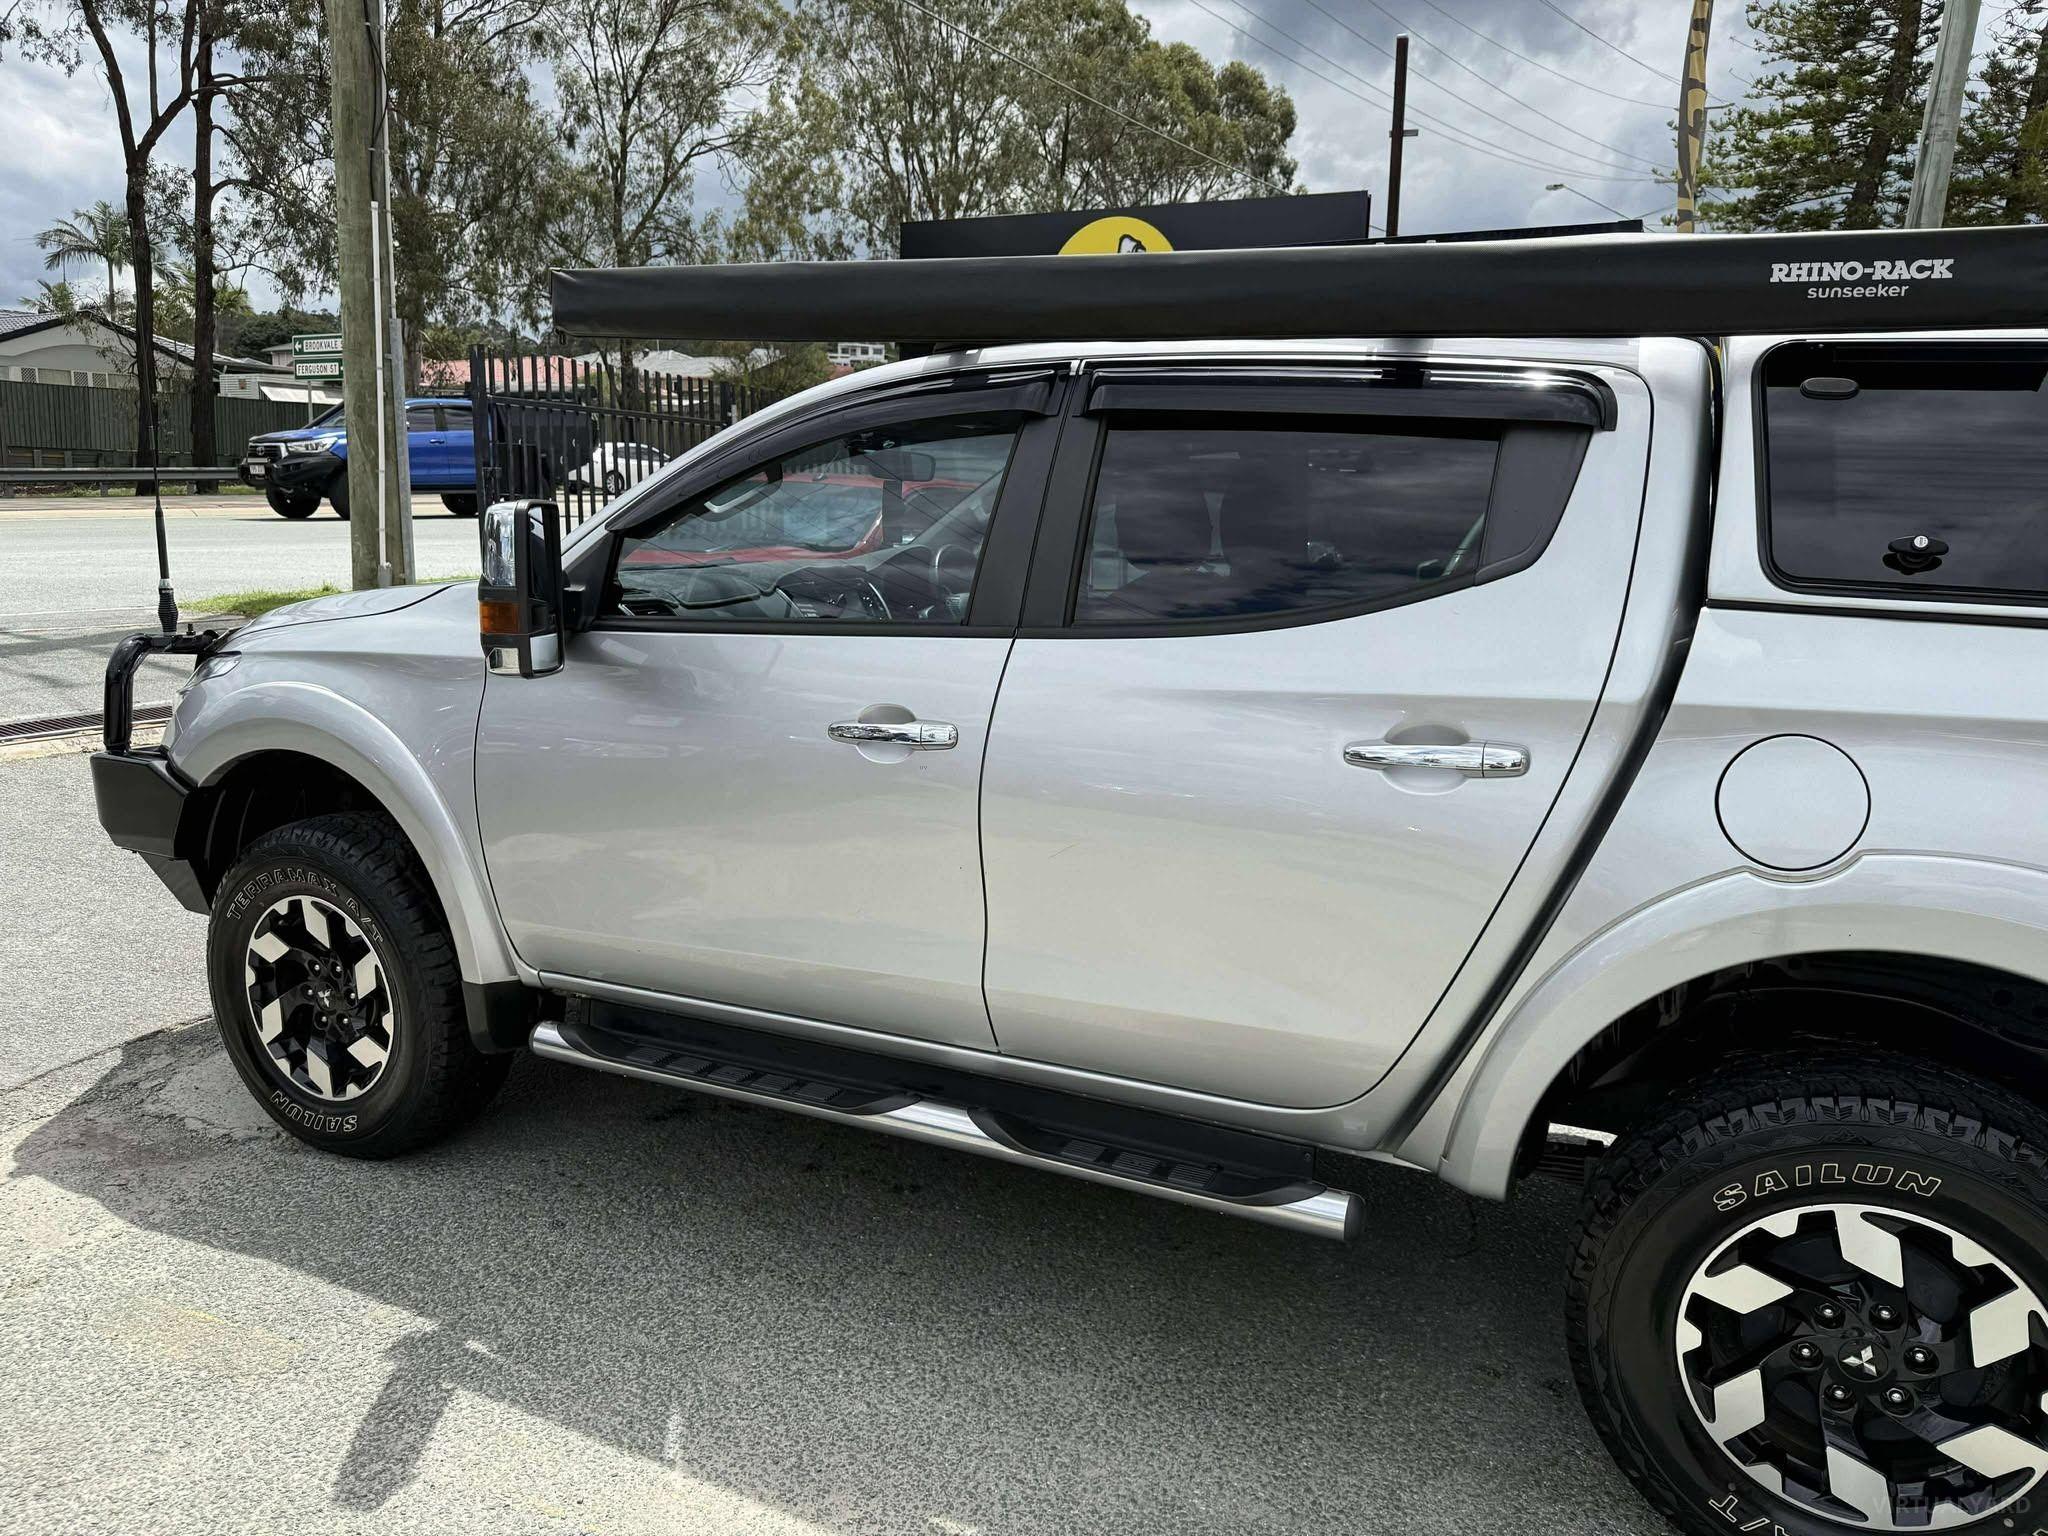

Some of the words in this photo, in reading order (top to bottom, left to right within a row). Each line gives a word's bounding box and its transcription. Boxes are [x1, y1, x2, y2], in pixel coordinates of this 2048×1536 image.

[1770, 258, 1954, 282] RHINO-RACK
[1807, 284, 1909, 299] sunseeker
[304, 340, 338, 351] BROOKVALE
[297, 364, 328, 375] FERGUSON
[330, 364, 338, 373] ST
[226, 867, 337, 920] TERRAMAX
[346, 897, 384, 942] A/T
[270, 1090, 358, 1132] SAILUN
[1713, 1163, 1941, 1211] SAILUN
